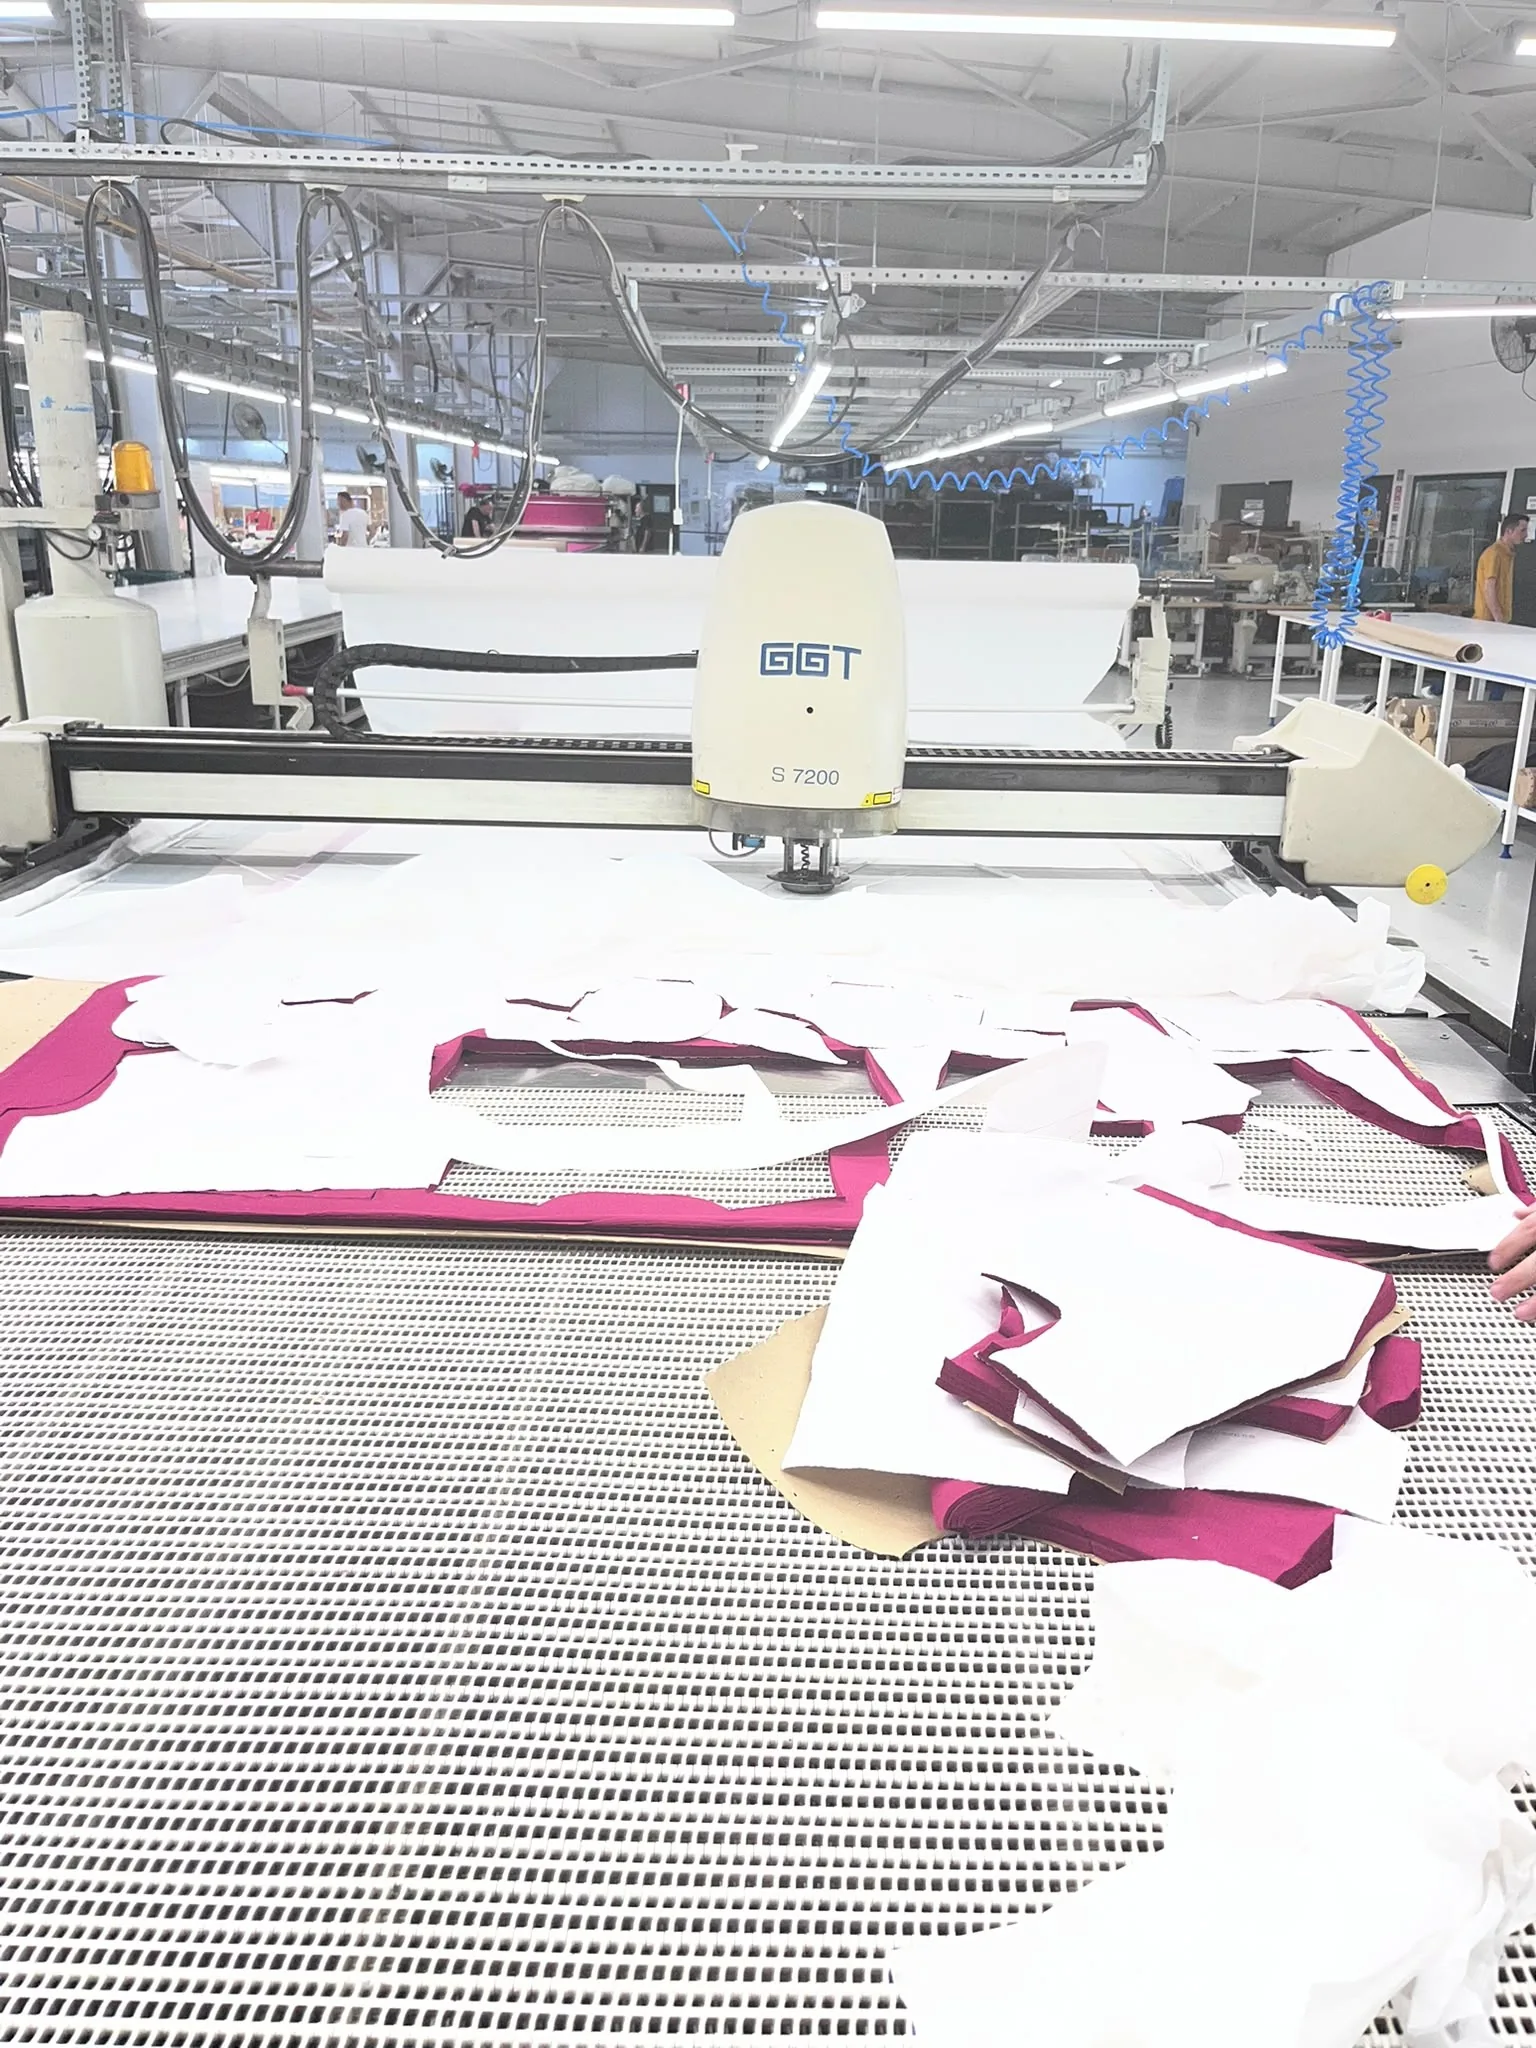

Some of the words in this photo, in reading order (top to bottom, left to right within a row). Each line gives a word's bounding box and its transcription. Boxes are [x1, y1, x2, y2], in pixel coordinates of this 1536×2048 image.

[760, 642, 862, 680] GGT
[771, 766, 785, 783] S
[793, 768, 840, 785] 7200
